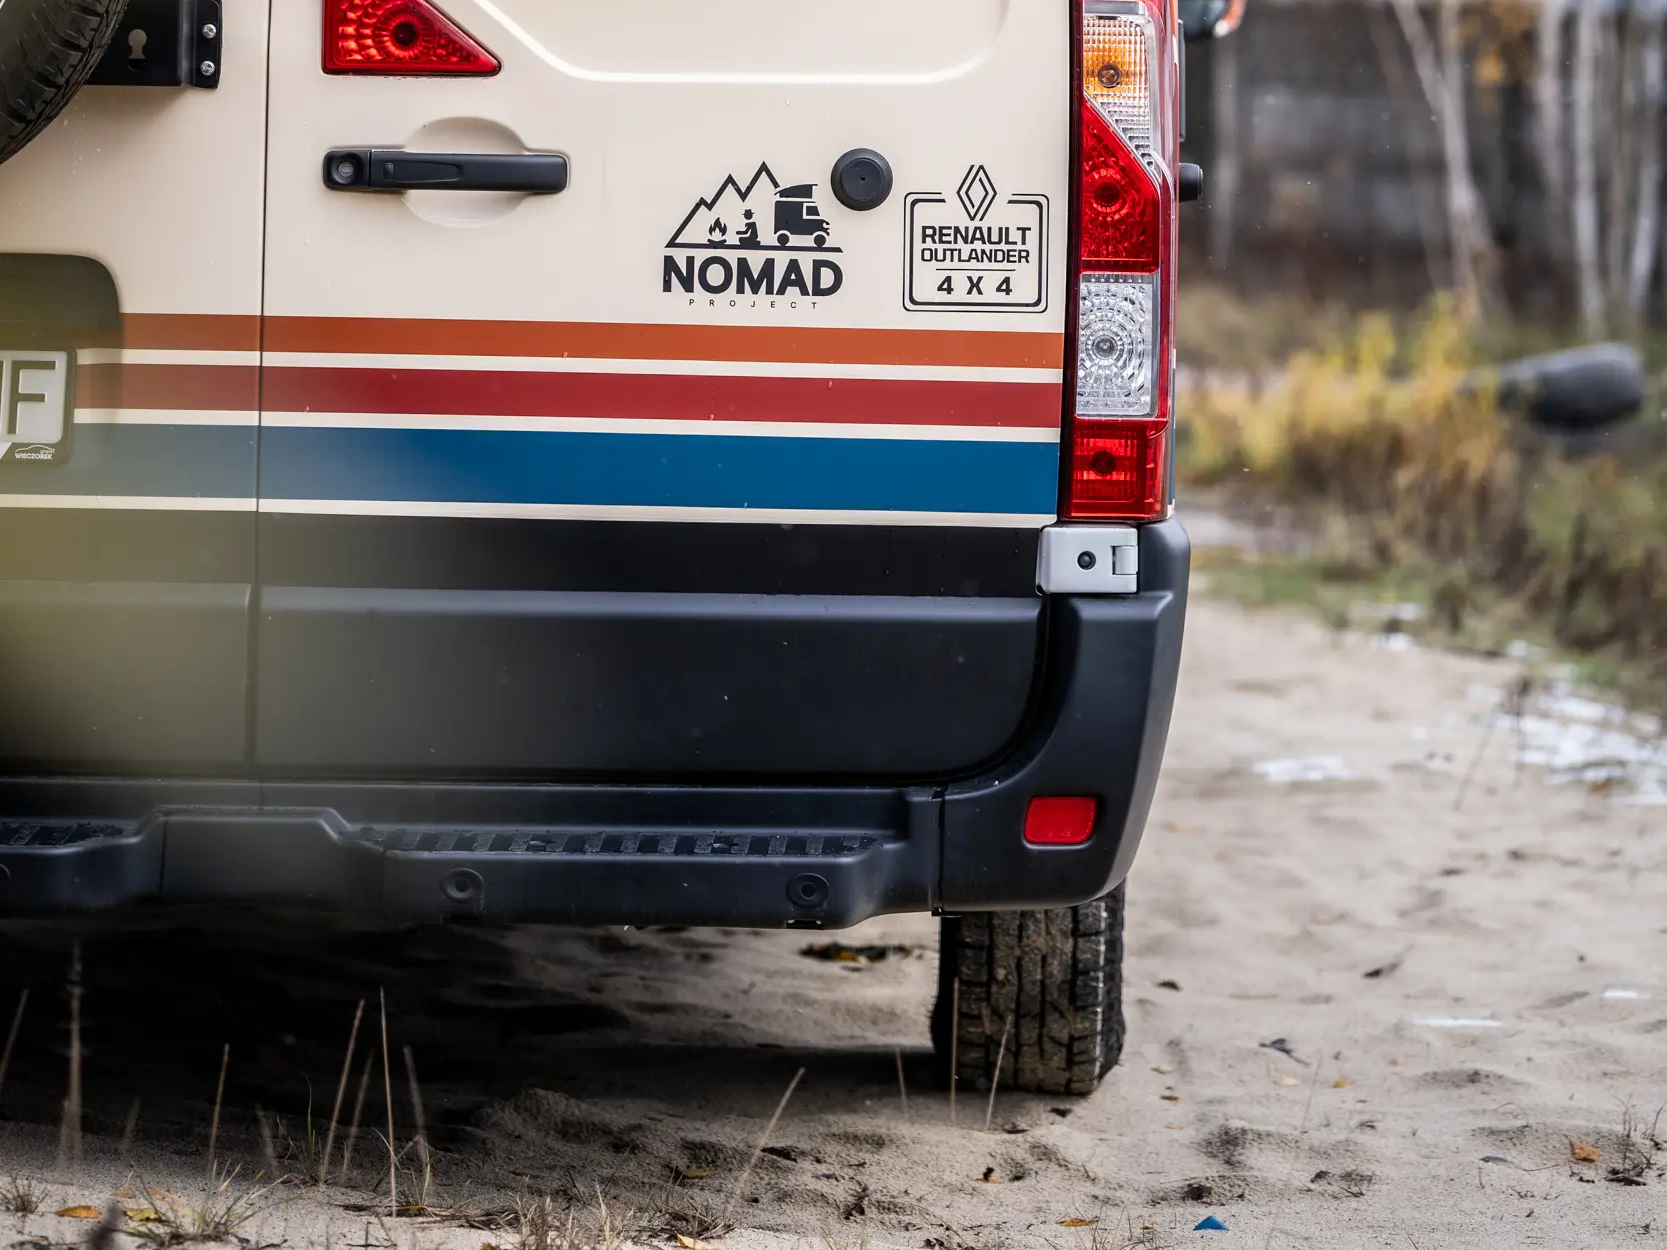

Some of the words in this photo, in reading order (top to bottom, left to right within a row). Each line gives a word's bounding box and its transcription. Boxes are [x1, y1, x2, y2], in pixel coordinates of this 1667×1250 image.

[921, 225, 1032, 246] RENAULT
[920, 248, 1030, 264] OUTLANDER
[662, 255, 843, 297] NOMAD
[688, 298, 817, 310] PROJECT
